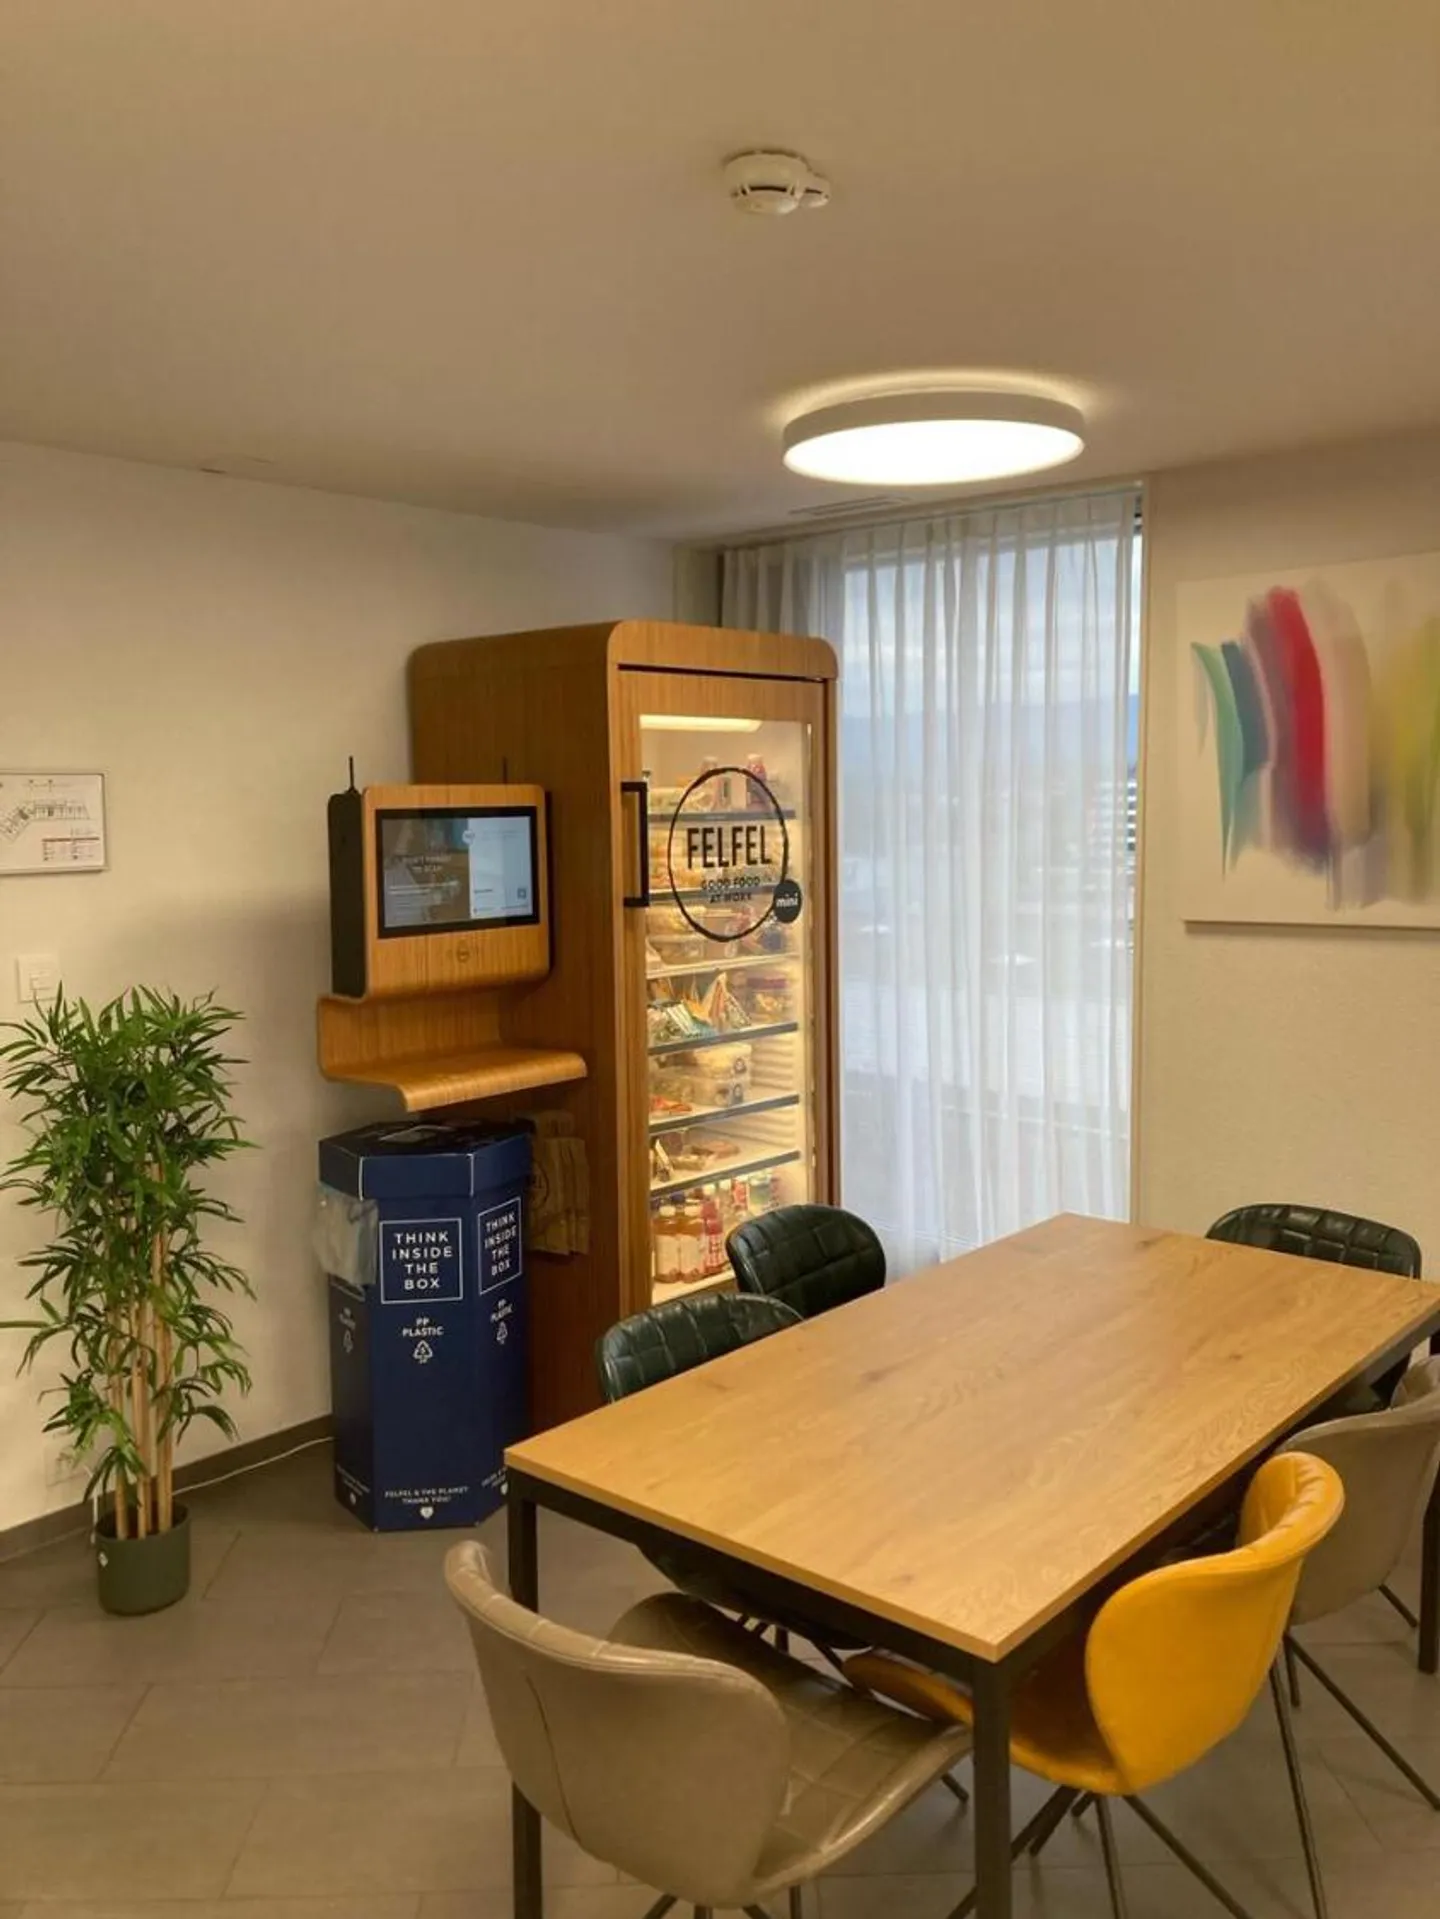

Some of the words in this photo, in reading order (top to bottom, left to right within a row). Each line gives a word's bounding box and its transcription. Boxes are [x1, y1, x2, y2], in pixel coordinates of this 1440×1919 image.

[687, 825, 772, 869] FELFEL
[701, 877, 731, 891] GOOD
[733, 876, 761, 888] FOOD
[776, 892, 798, 907] mini
[486, 1212, 515, 1232] THINK
[394, 1231, 449, 1244] THINK
[484, 1225, 517, 1248] INSIDE
[392, 1247, 453, 1260] INSIDE
[492, 1245, 509, 1262] THE
[404, 1262, 438, 1275] THE
[491, 1259, 510, 1276] BOX
[404, 1277, 440, 1290] BOX
[489, 1303, 513, 1323] PLASTIC
[415, 1317, 430, 1326] PP
[402, 1326, 445, 1338] PLASTIC
